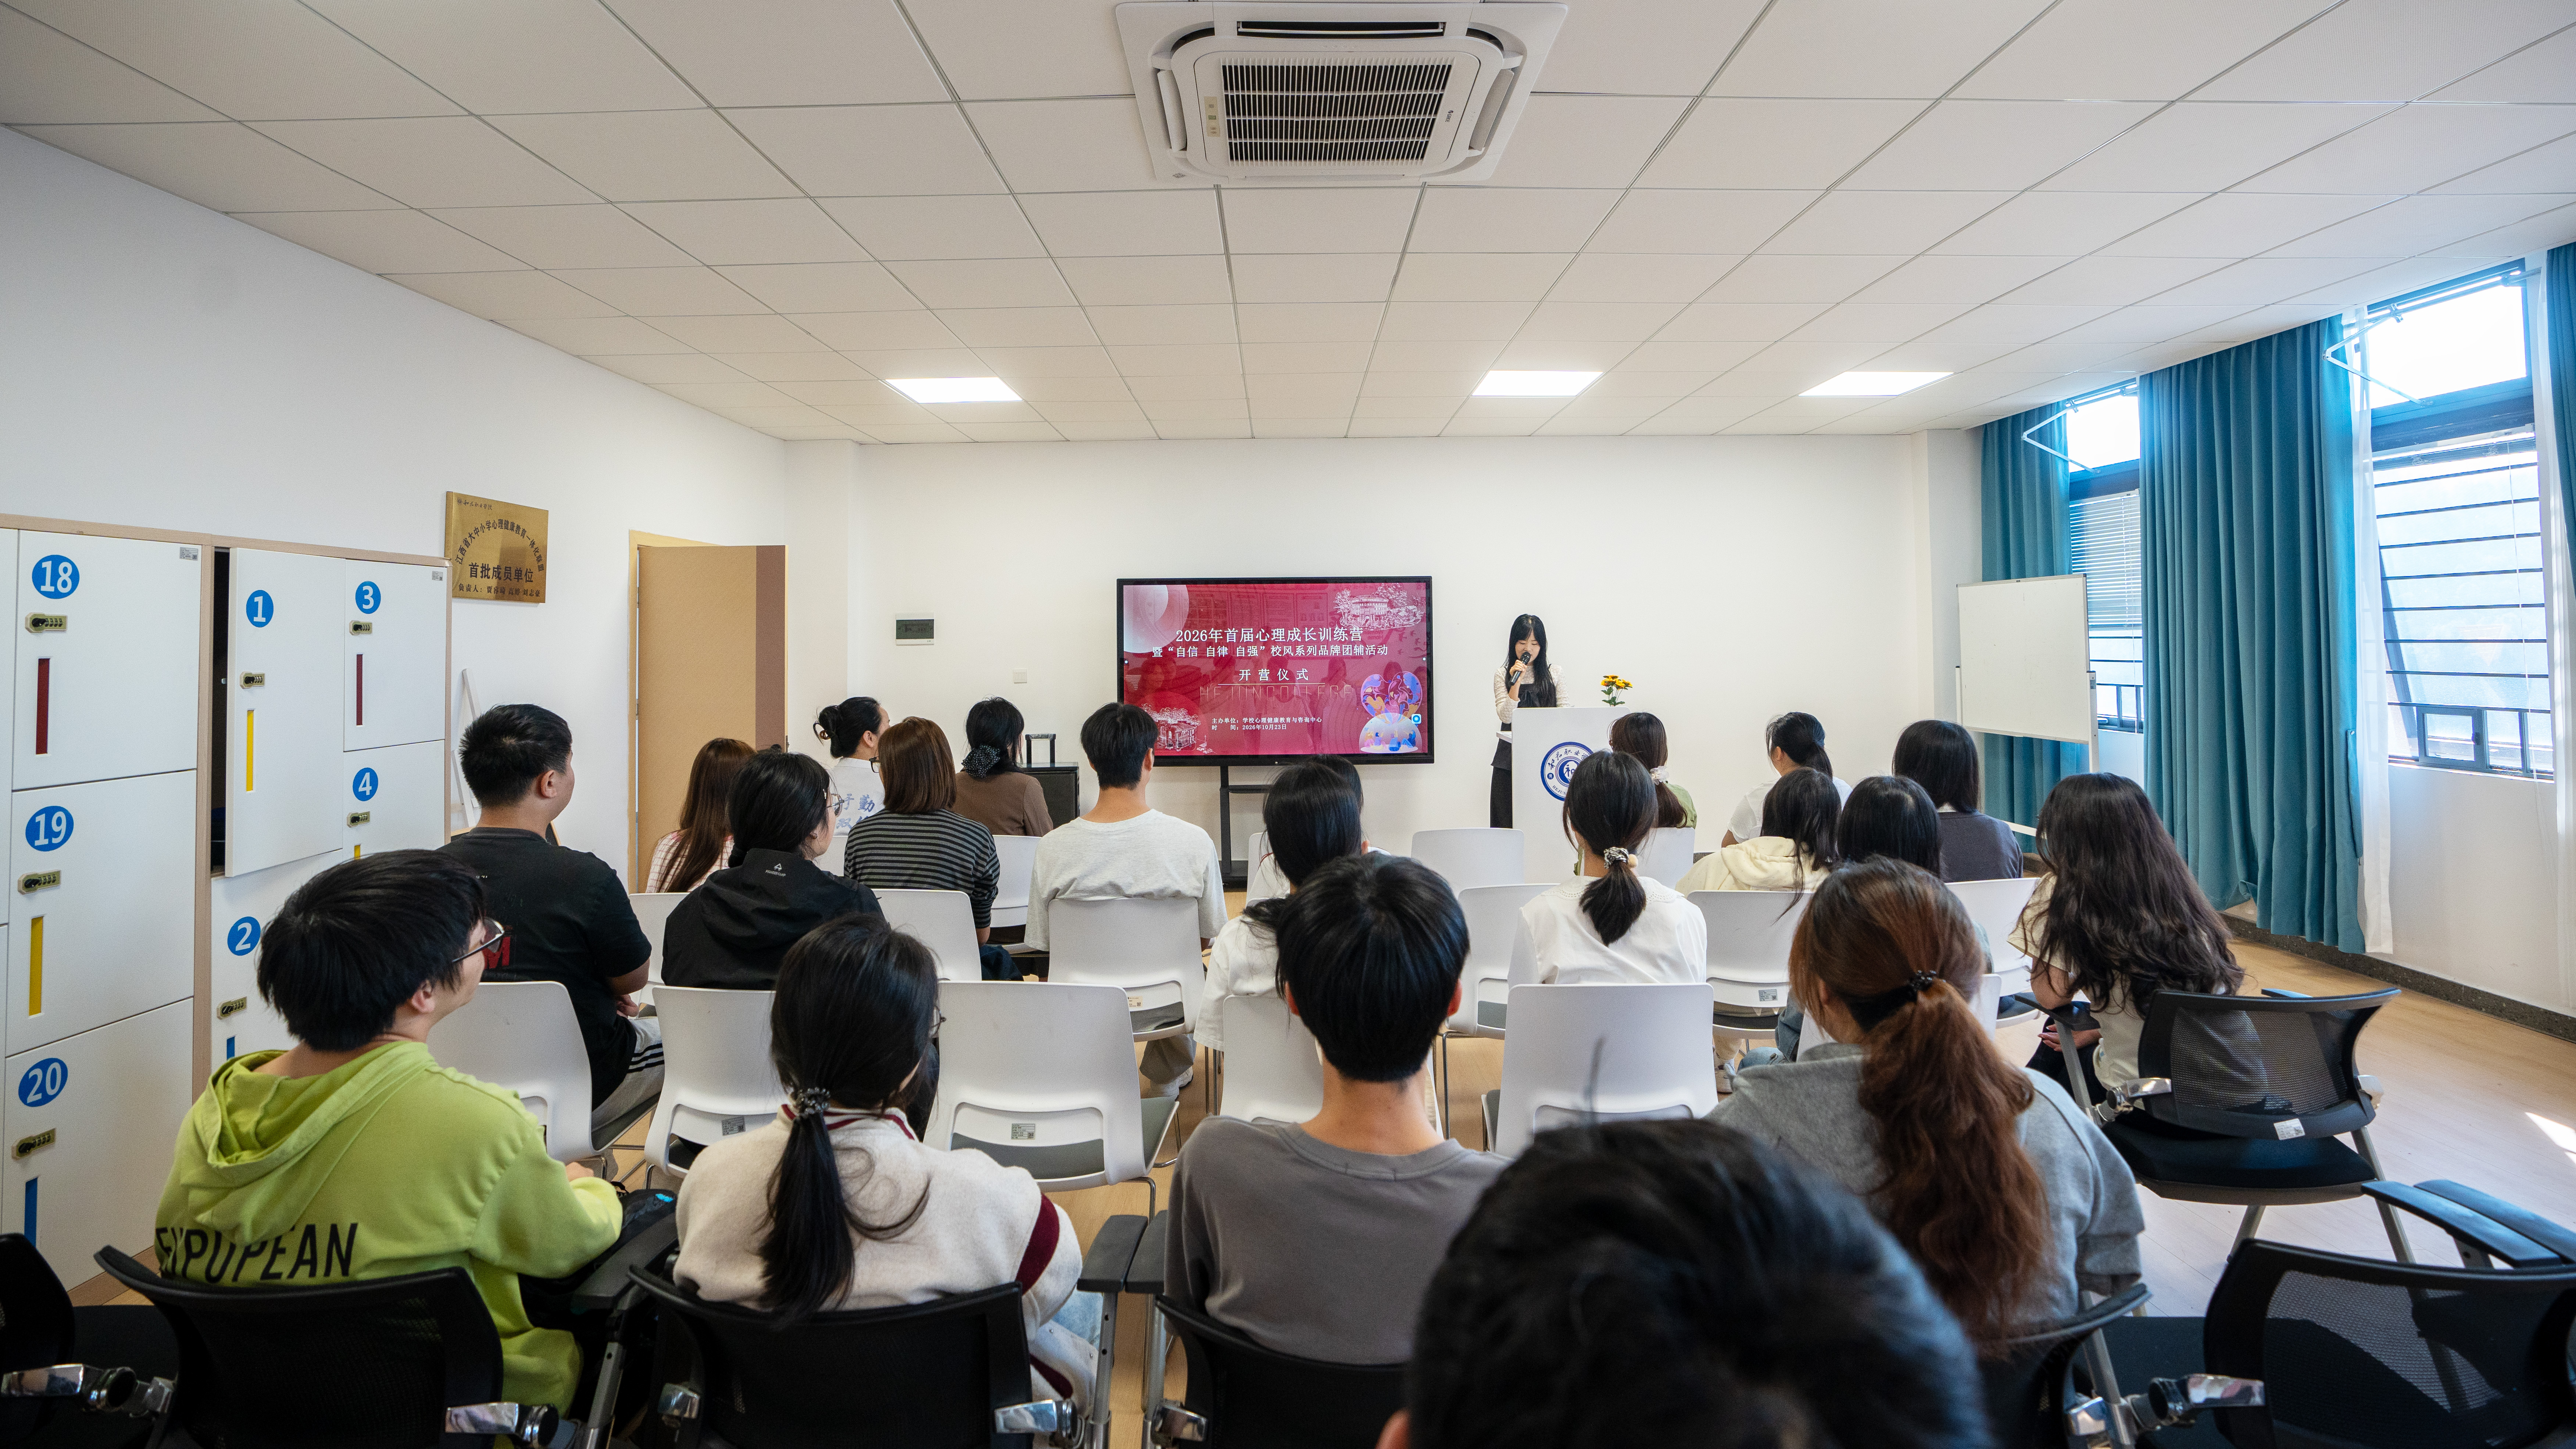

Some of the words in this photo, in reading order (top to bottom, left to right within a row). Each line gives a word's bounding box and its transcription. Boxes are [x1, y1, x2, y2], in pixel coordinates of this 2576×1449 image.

[455, 519, 544, 572] 江西省大中小学心理健康教育一体化联盟
[41, 561, 72, 593] 18
[468, 562, 533, 583] 首批成员单位
[254, 596, 265, 622] 1
[363, 586, 373, 609] 3
[1176, 627, 1363, 643] 2026年首届心理成长训练营
[359, 773, 371, 795] 4
[35, 812, 66, 845] 19
[236, 923, 251, 950] 2
[27, 1062, 61, 1103] 20
